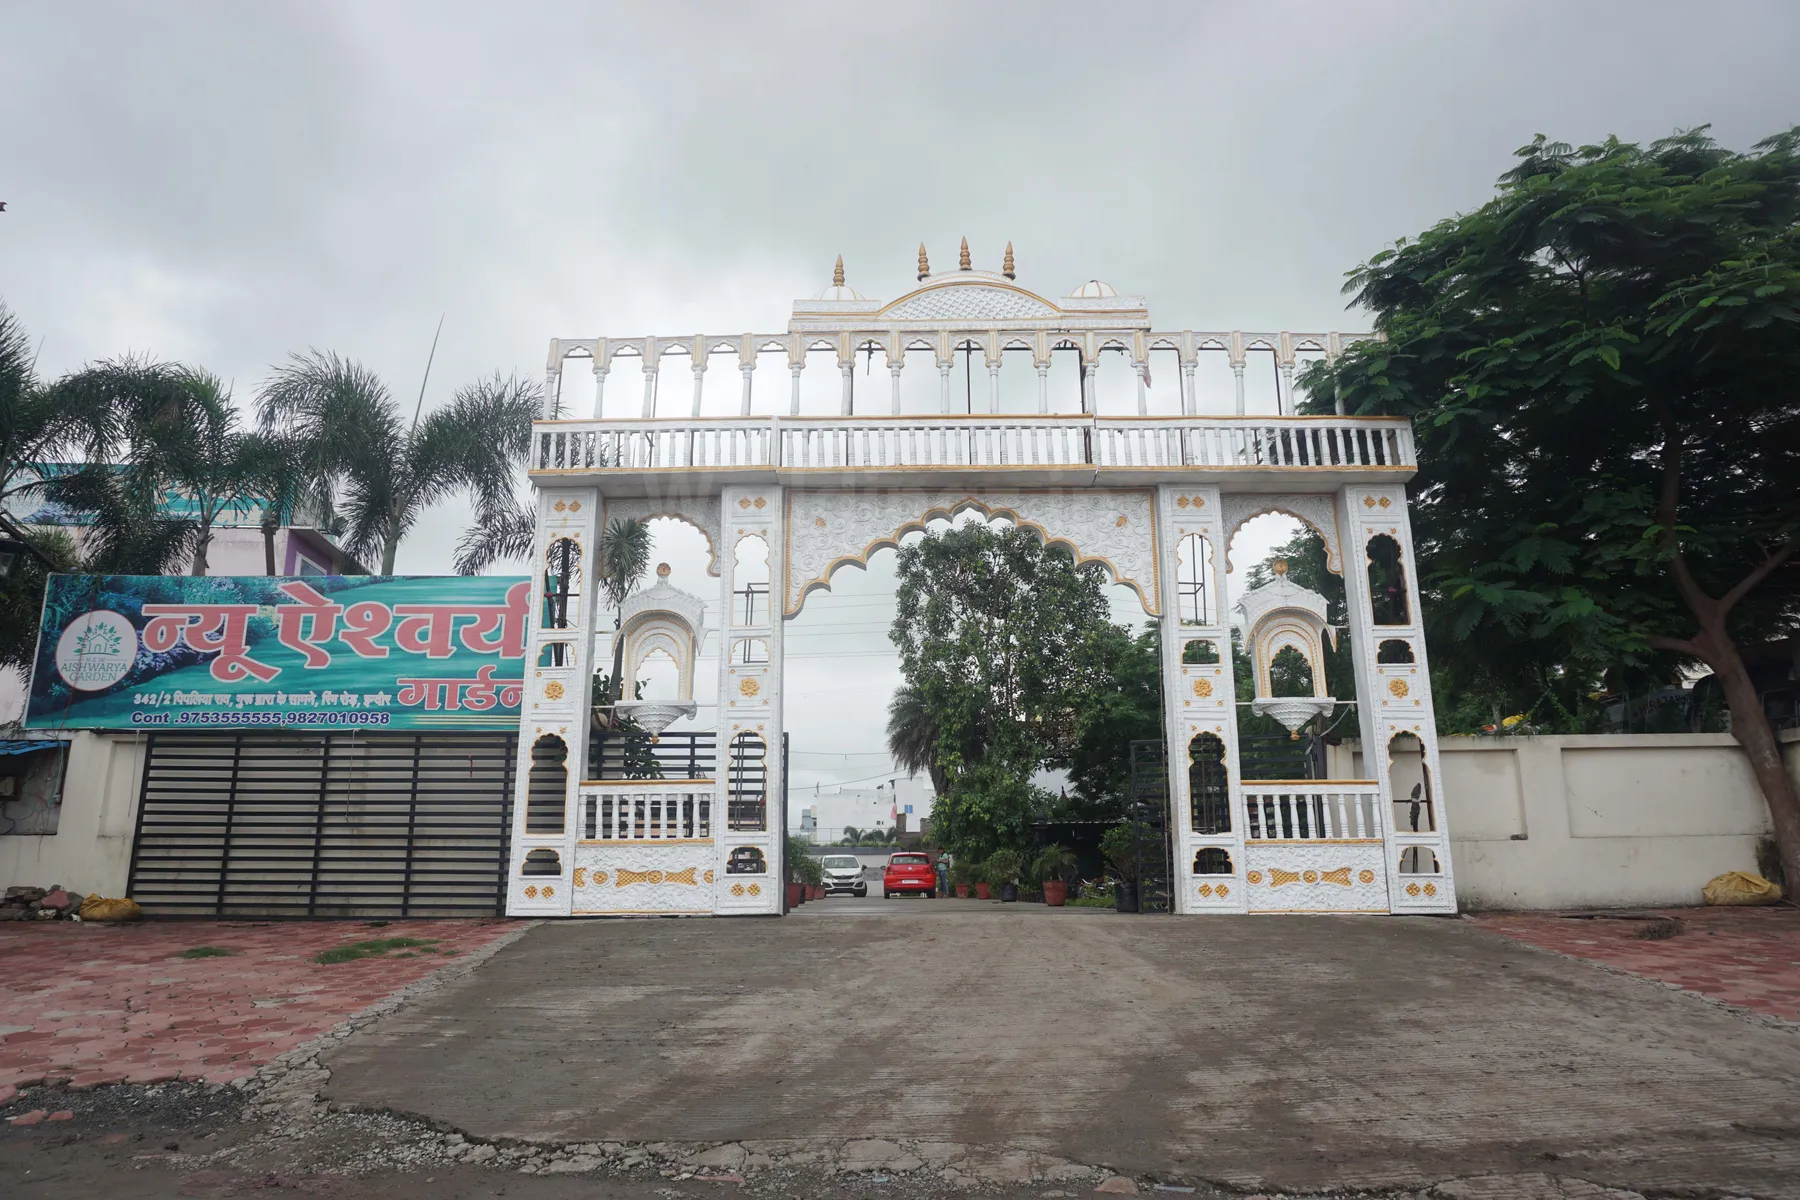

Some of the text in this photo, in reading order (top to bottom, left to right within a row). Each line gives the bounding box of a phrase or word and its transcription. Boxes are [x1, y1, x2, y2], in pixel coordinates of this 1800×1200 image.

[141, 603, 283, 683] न्यू
[60, 662, 127, 672] AISHWARYA
[69, 671, 117, 682] GARDEN
[131, 710, 170, 725] Cont
